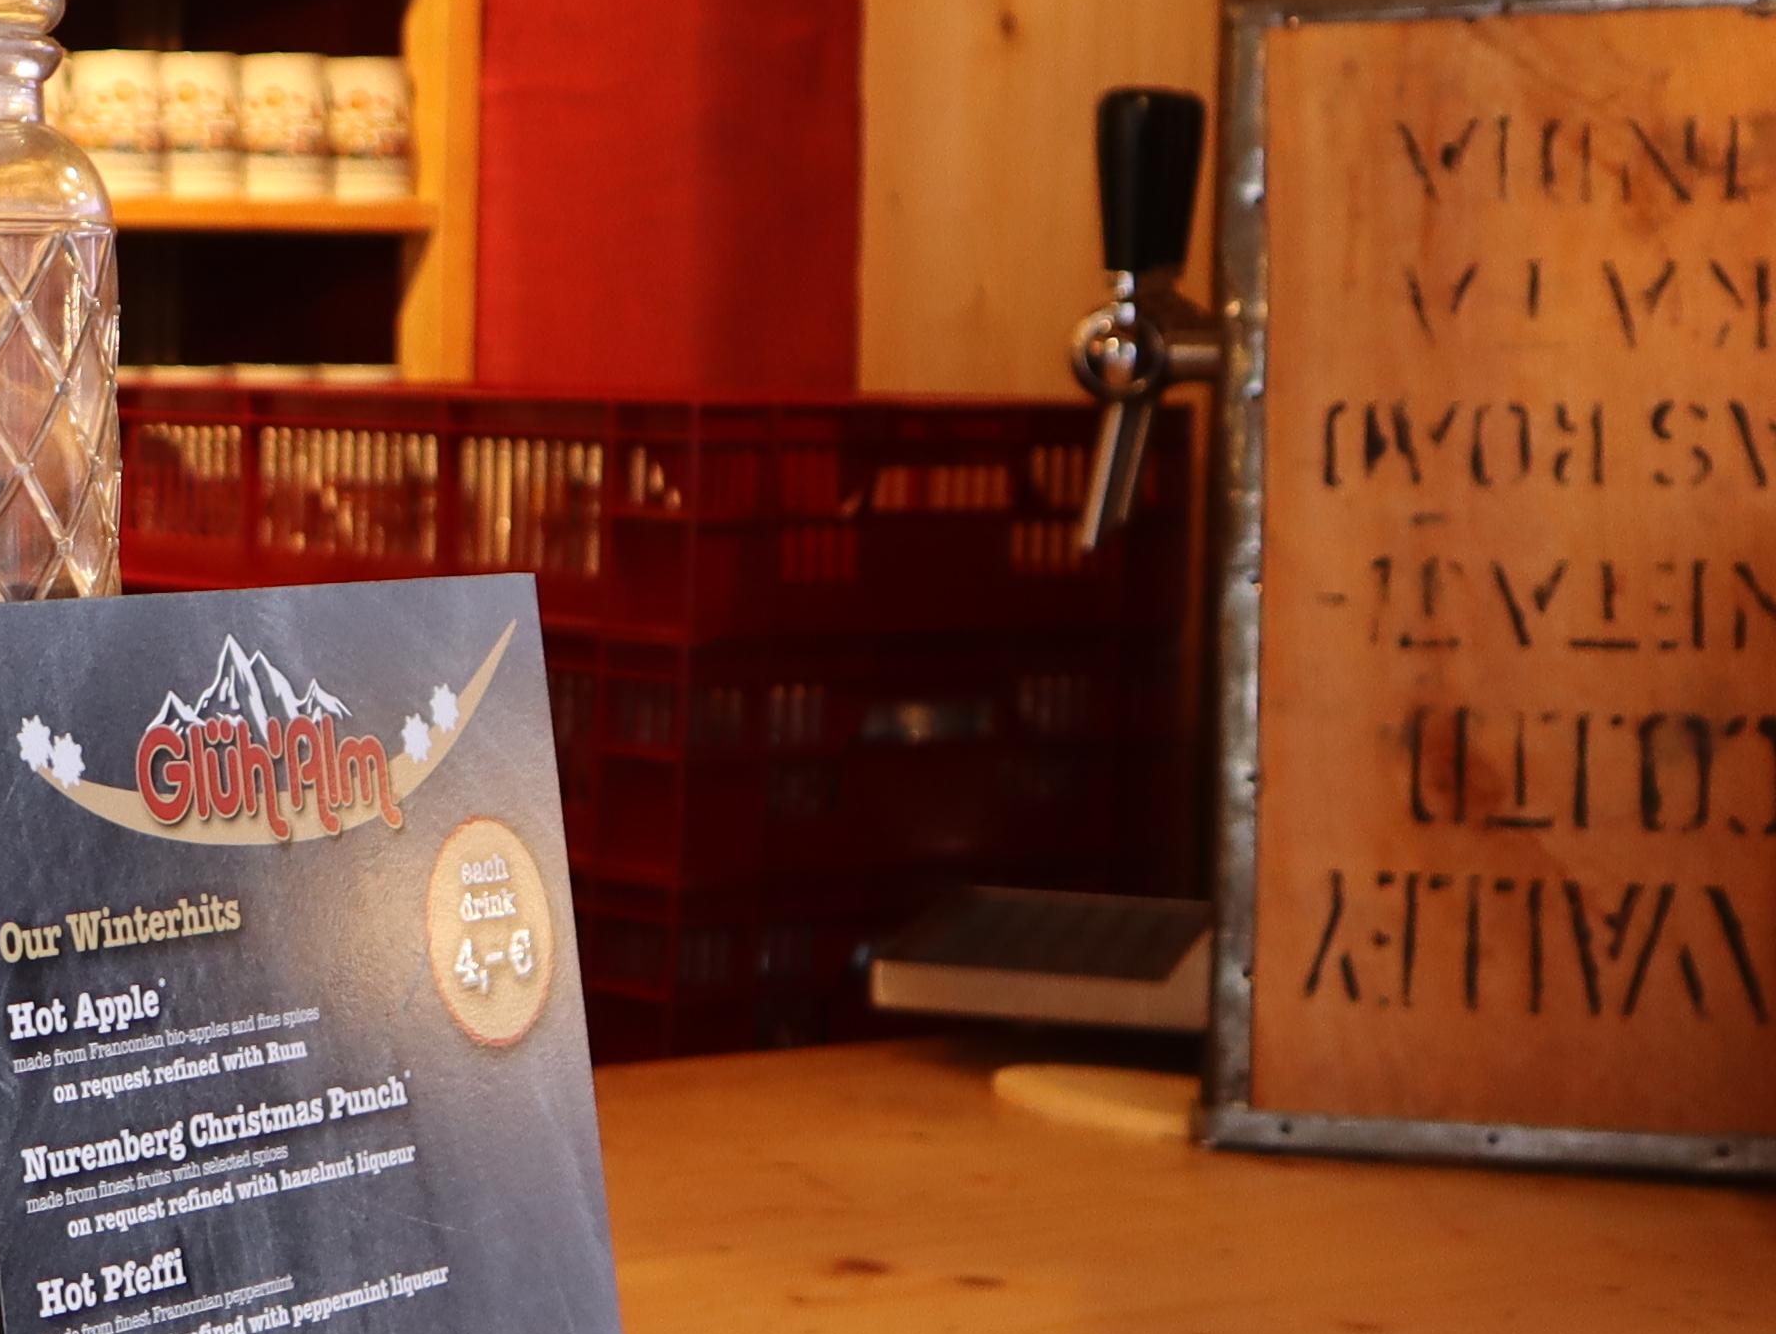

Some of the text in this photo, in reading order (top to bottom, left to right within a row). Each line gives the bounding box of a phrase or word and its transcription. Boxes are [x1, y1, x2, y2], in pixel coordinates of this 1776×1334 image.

[135, 713, 403, 842] Glüh'Alm
[461, 854, 510, 885] each
[1, 894, 240, 964] Our Winterhits
[460, 888, 517, 922] drink
[8, 998, 67, 1040] Hot
[13, 1007, 320, 1074] made from Franconian bio-apples and fine spices
[21, 1120, 186, 1183] Nuremberg
[190, 1097, 323, 1148] Christmas
[68, 1145, 415, 1238] on request refined with hazelnut liqueur
[37, 1247, 186, 1318] Hot Pfeffi
